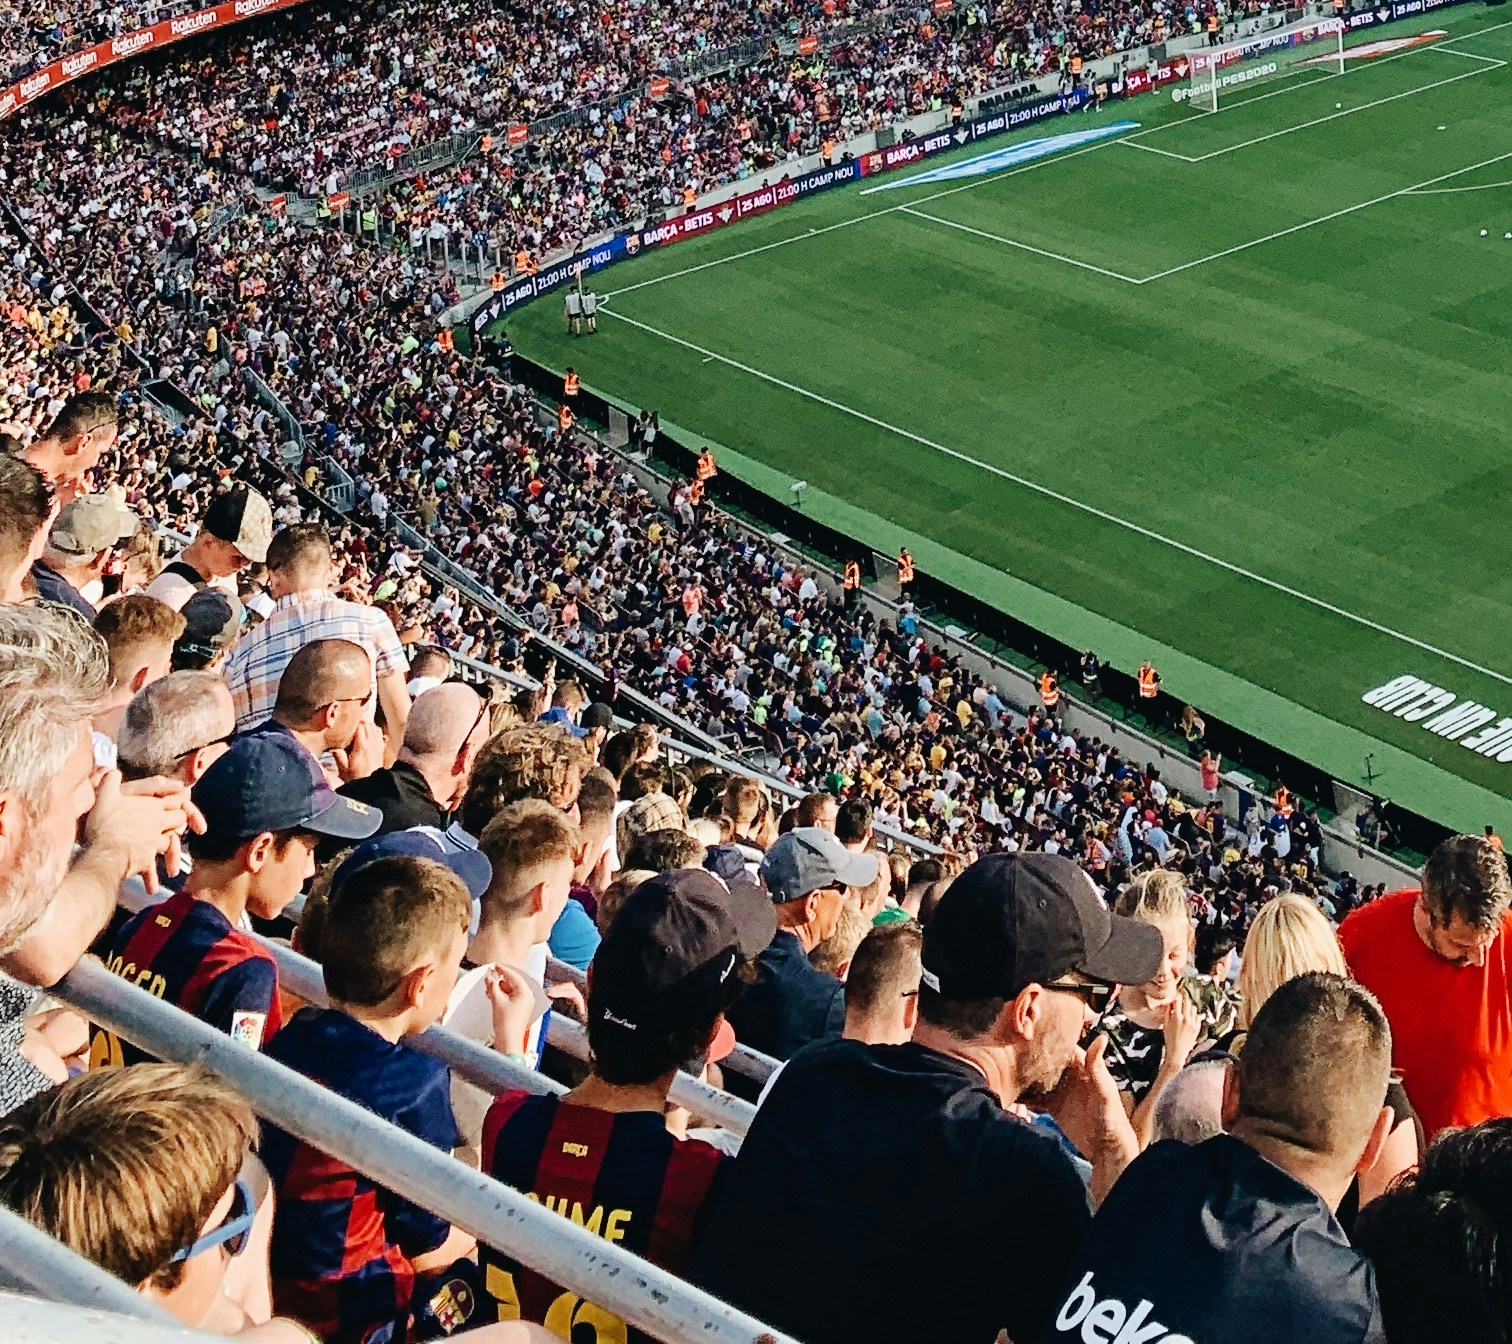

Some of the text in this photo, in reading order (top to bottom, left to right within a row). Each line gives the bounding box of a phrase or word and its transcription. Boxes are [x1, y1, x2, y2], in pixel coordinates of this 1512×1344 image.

[171, 11, 217, 35] Rakuten
[1350, 11, 1374, 27] BETIS
[1396, 5, 1405, 15] 25
[1406, 2, 1421, 13] AGO
[112, 31, 154, 56] Rakuten
[61, 52, 98, 76] Rakuten
[1222, 62, 1278, 88] PES2020
[20, 72, 51, 99] Rakuten
[887, 143, 920, 165] BARÇA
[924, 133, 950, 153] BETIS
[976, 124, 986, 136] 25
[986, 118, 1005, 133] AGO
[1010, 108, 1031, 125] 21:00
[1031, 107, 1039, 118] H
[1038, 100, 1062, 116] CAMP
[643, 165, 854, 246] BARÇA BETIS 25 AGO 21:00 H CAMP NOU
[505, 250, 612, 307] 25 AGO 21:00 H CAMP NOU
[1361, 674, 1457, 723] CLUB
[1421, 700, 1498, 741] UN
